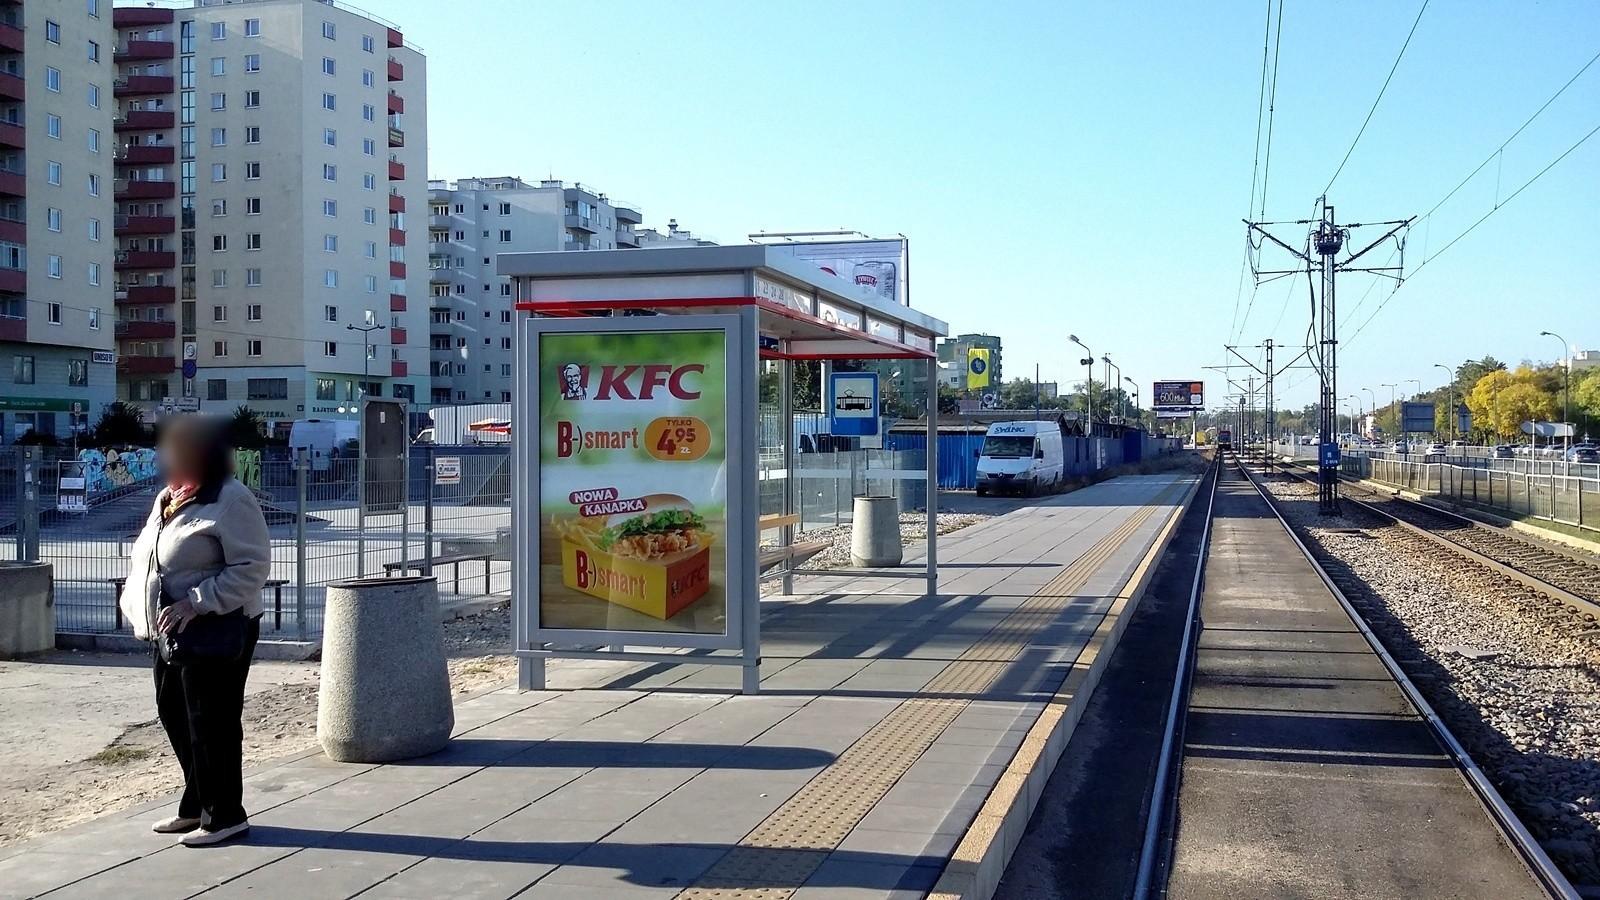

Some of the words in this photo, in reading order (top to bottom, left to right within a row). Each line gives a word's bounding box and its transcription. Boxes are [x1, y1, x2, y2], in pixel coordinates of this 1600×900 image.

[593, 364, 704, 400] KFC
[585, 427, 639, 449] smart
[994, 426, 1026, 434] SWING
[574, 489, 614, 503] NOWA
[585, 499, 644, 515] KANAPKA
[599, 568, 647, 600] smart
